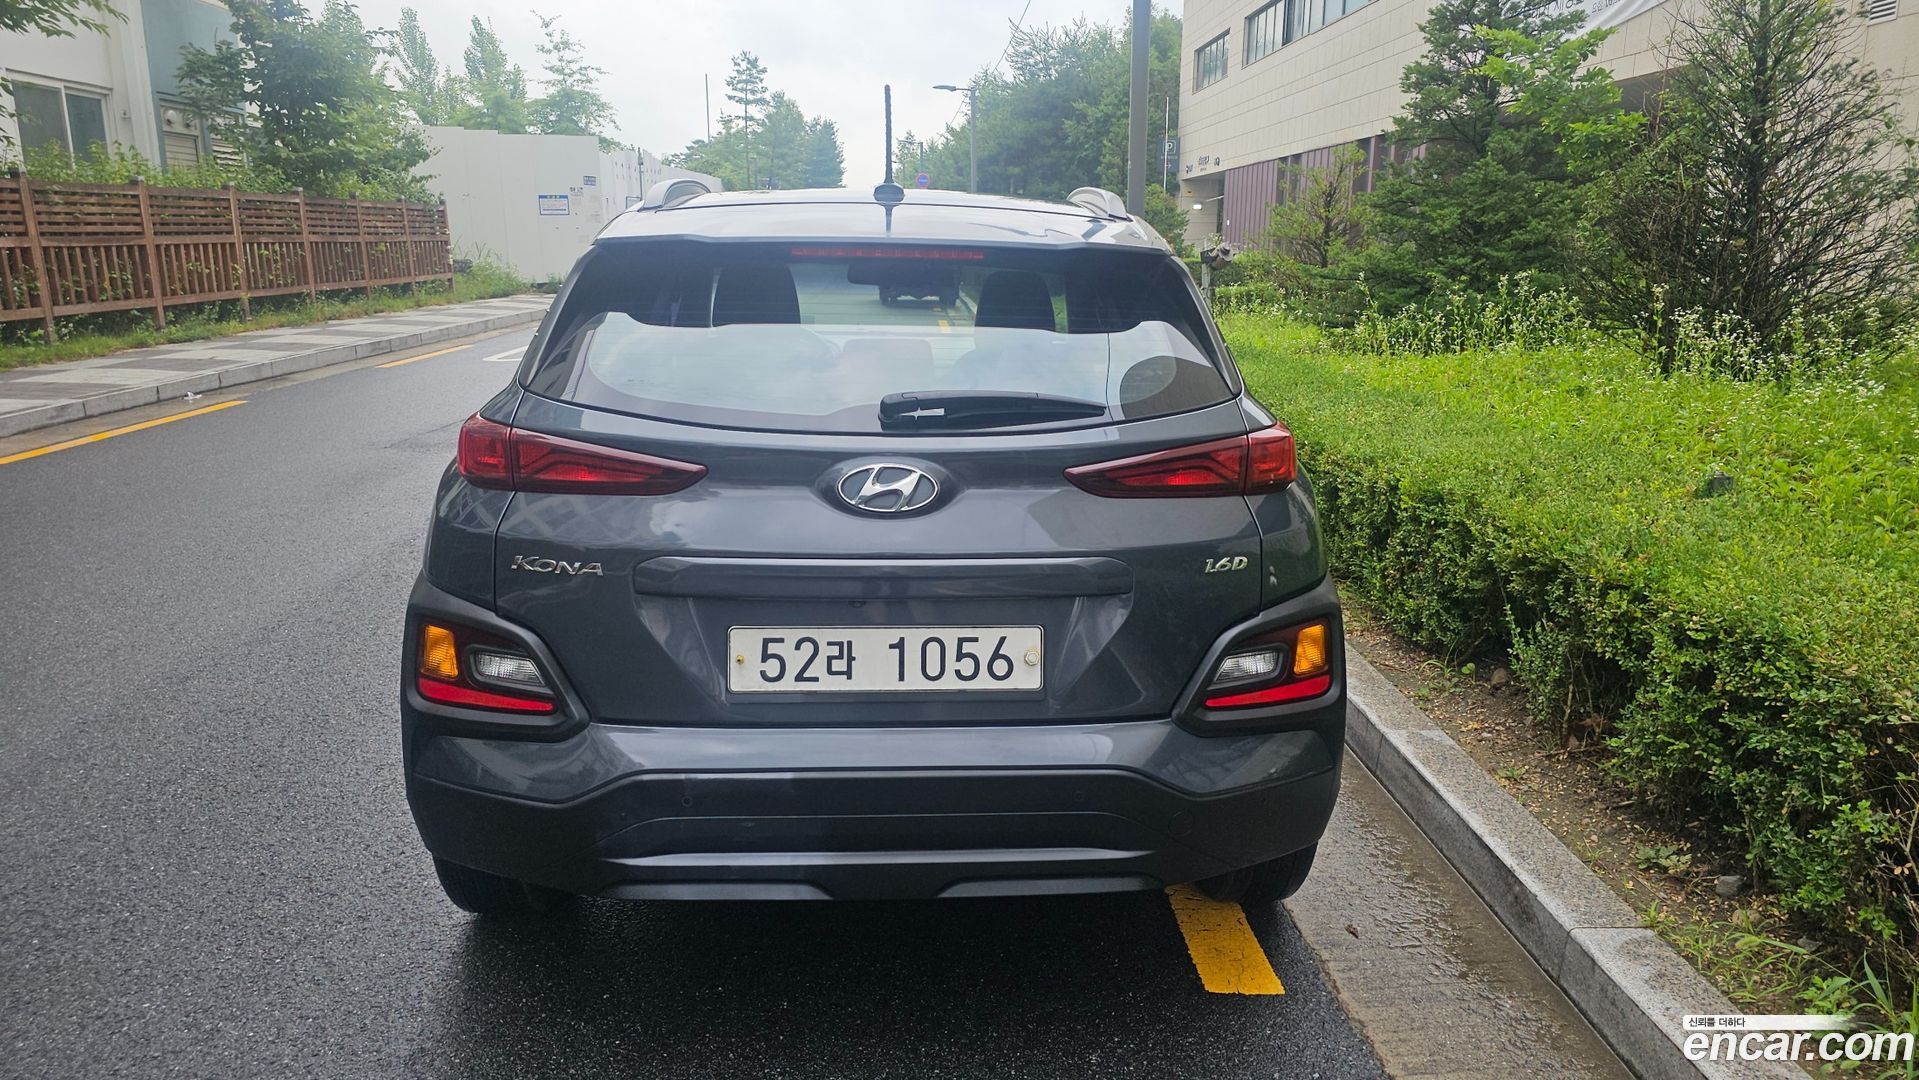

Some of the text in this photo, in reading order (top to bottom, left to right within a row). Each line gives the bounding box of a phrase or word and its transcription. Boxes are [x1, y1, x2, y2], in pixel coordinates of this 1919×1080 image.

[511, 555, 603, 576] KONA
[759, 636, 1014, 683] 52라 1056
